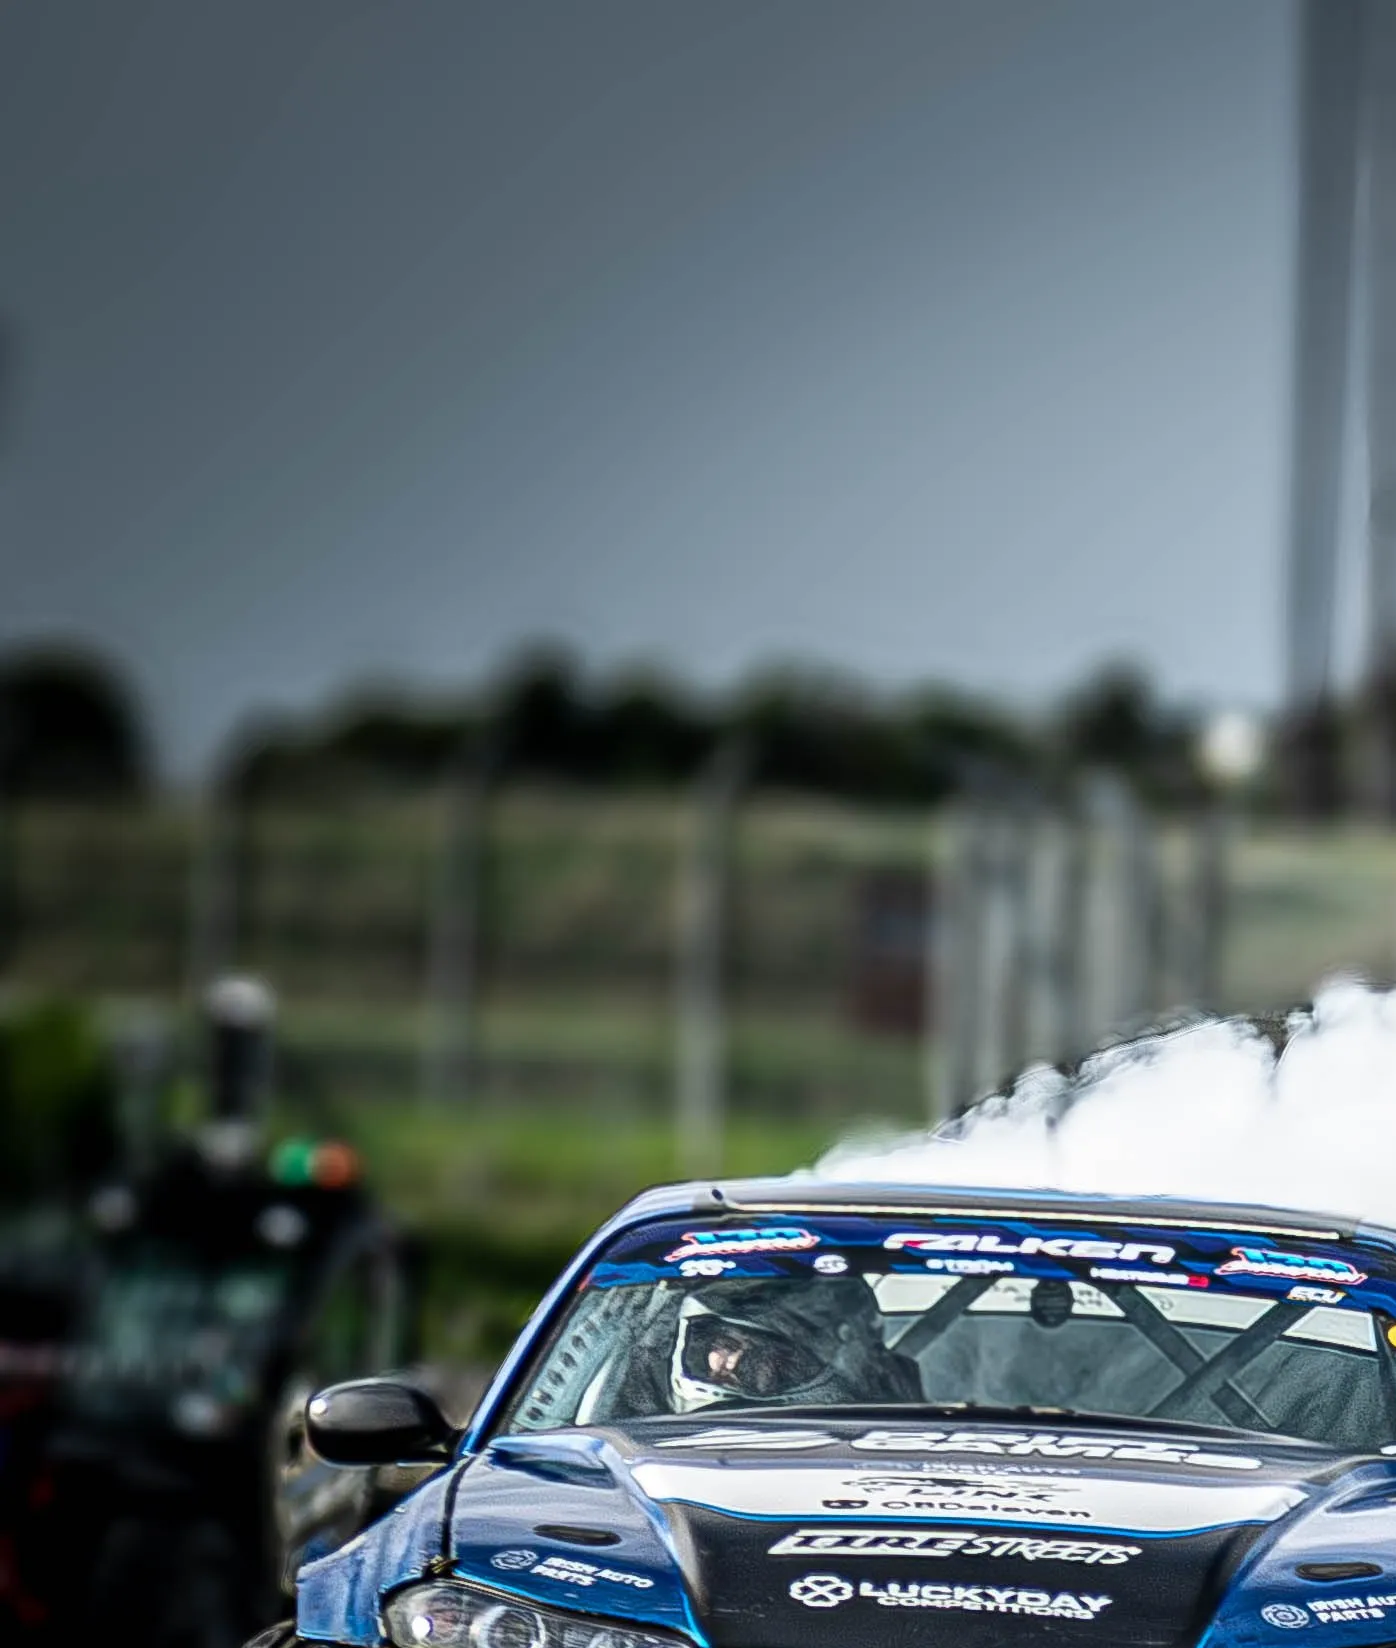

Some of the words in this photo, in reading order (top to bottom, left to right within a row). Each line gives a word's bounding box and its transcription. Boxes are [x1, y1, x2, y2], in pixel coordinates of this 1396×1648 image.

[883, 1233, 1176, 1263] FALKEN
[594, 1569, 655, 1588] AUTO
[859, 1582, 1114, 1614] LUCKYDAY
[877, 1596, 1095, 1619] COMPETITIONS
[1306, 1597, 1365, 1612] IRISH
[1316, 1608, 1386, 1624] PARTS
